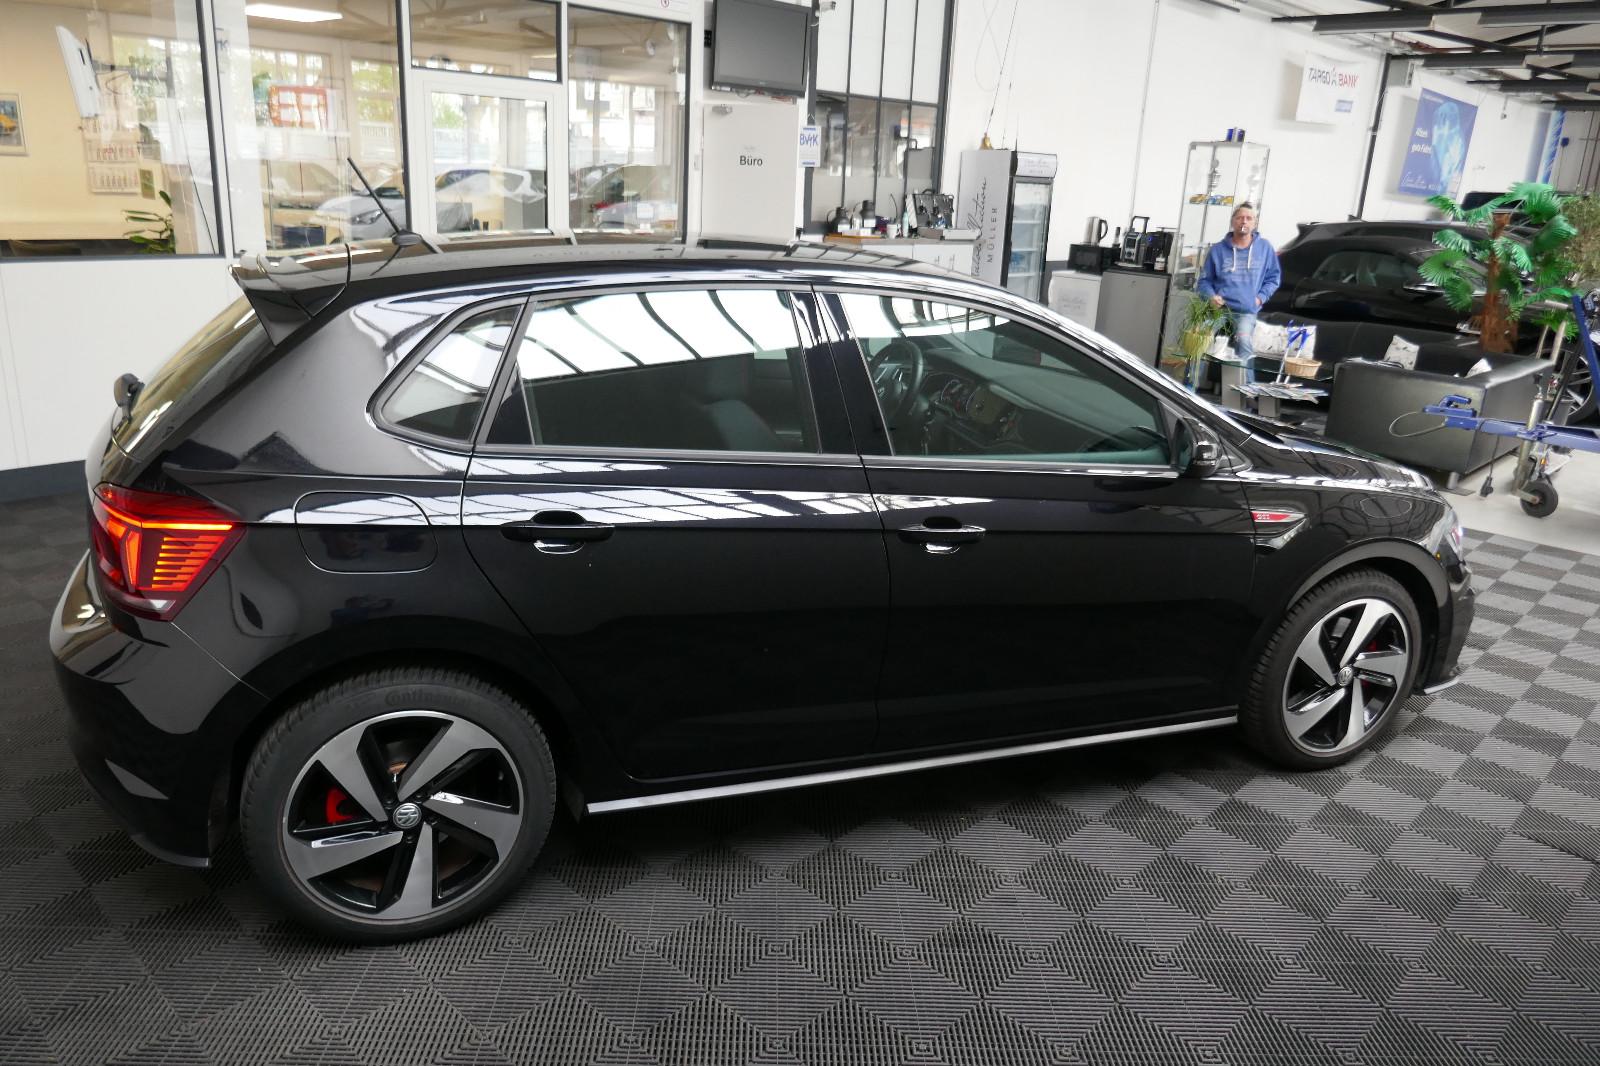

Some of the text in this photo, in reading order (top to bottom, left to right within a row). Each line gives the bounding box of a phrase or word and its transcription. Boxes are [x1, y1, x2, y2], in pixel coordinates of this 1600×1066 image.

[1308, 67, 1359, 88] TARGO BANK
[739, 154, 764, 167] Büro
